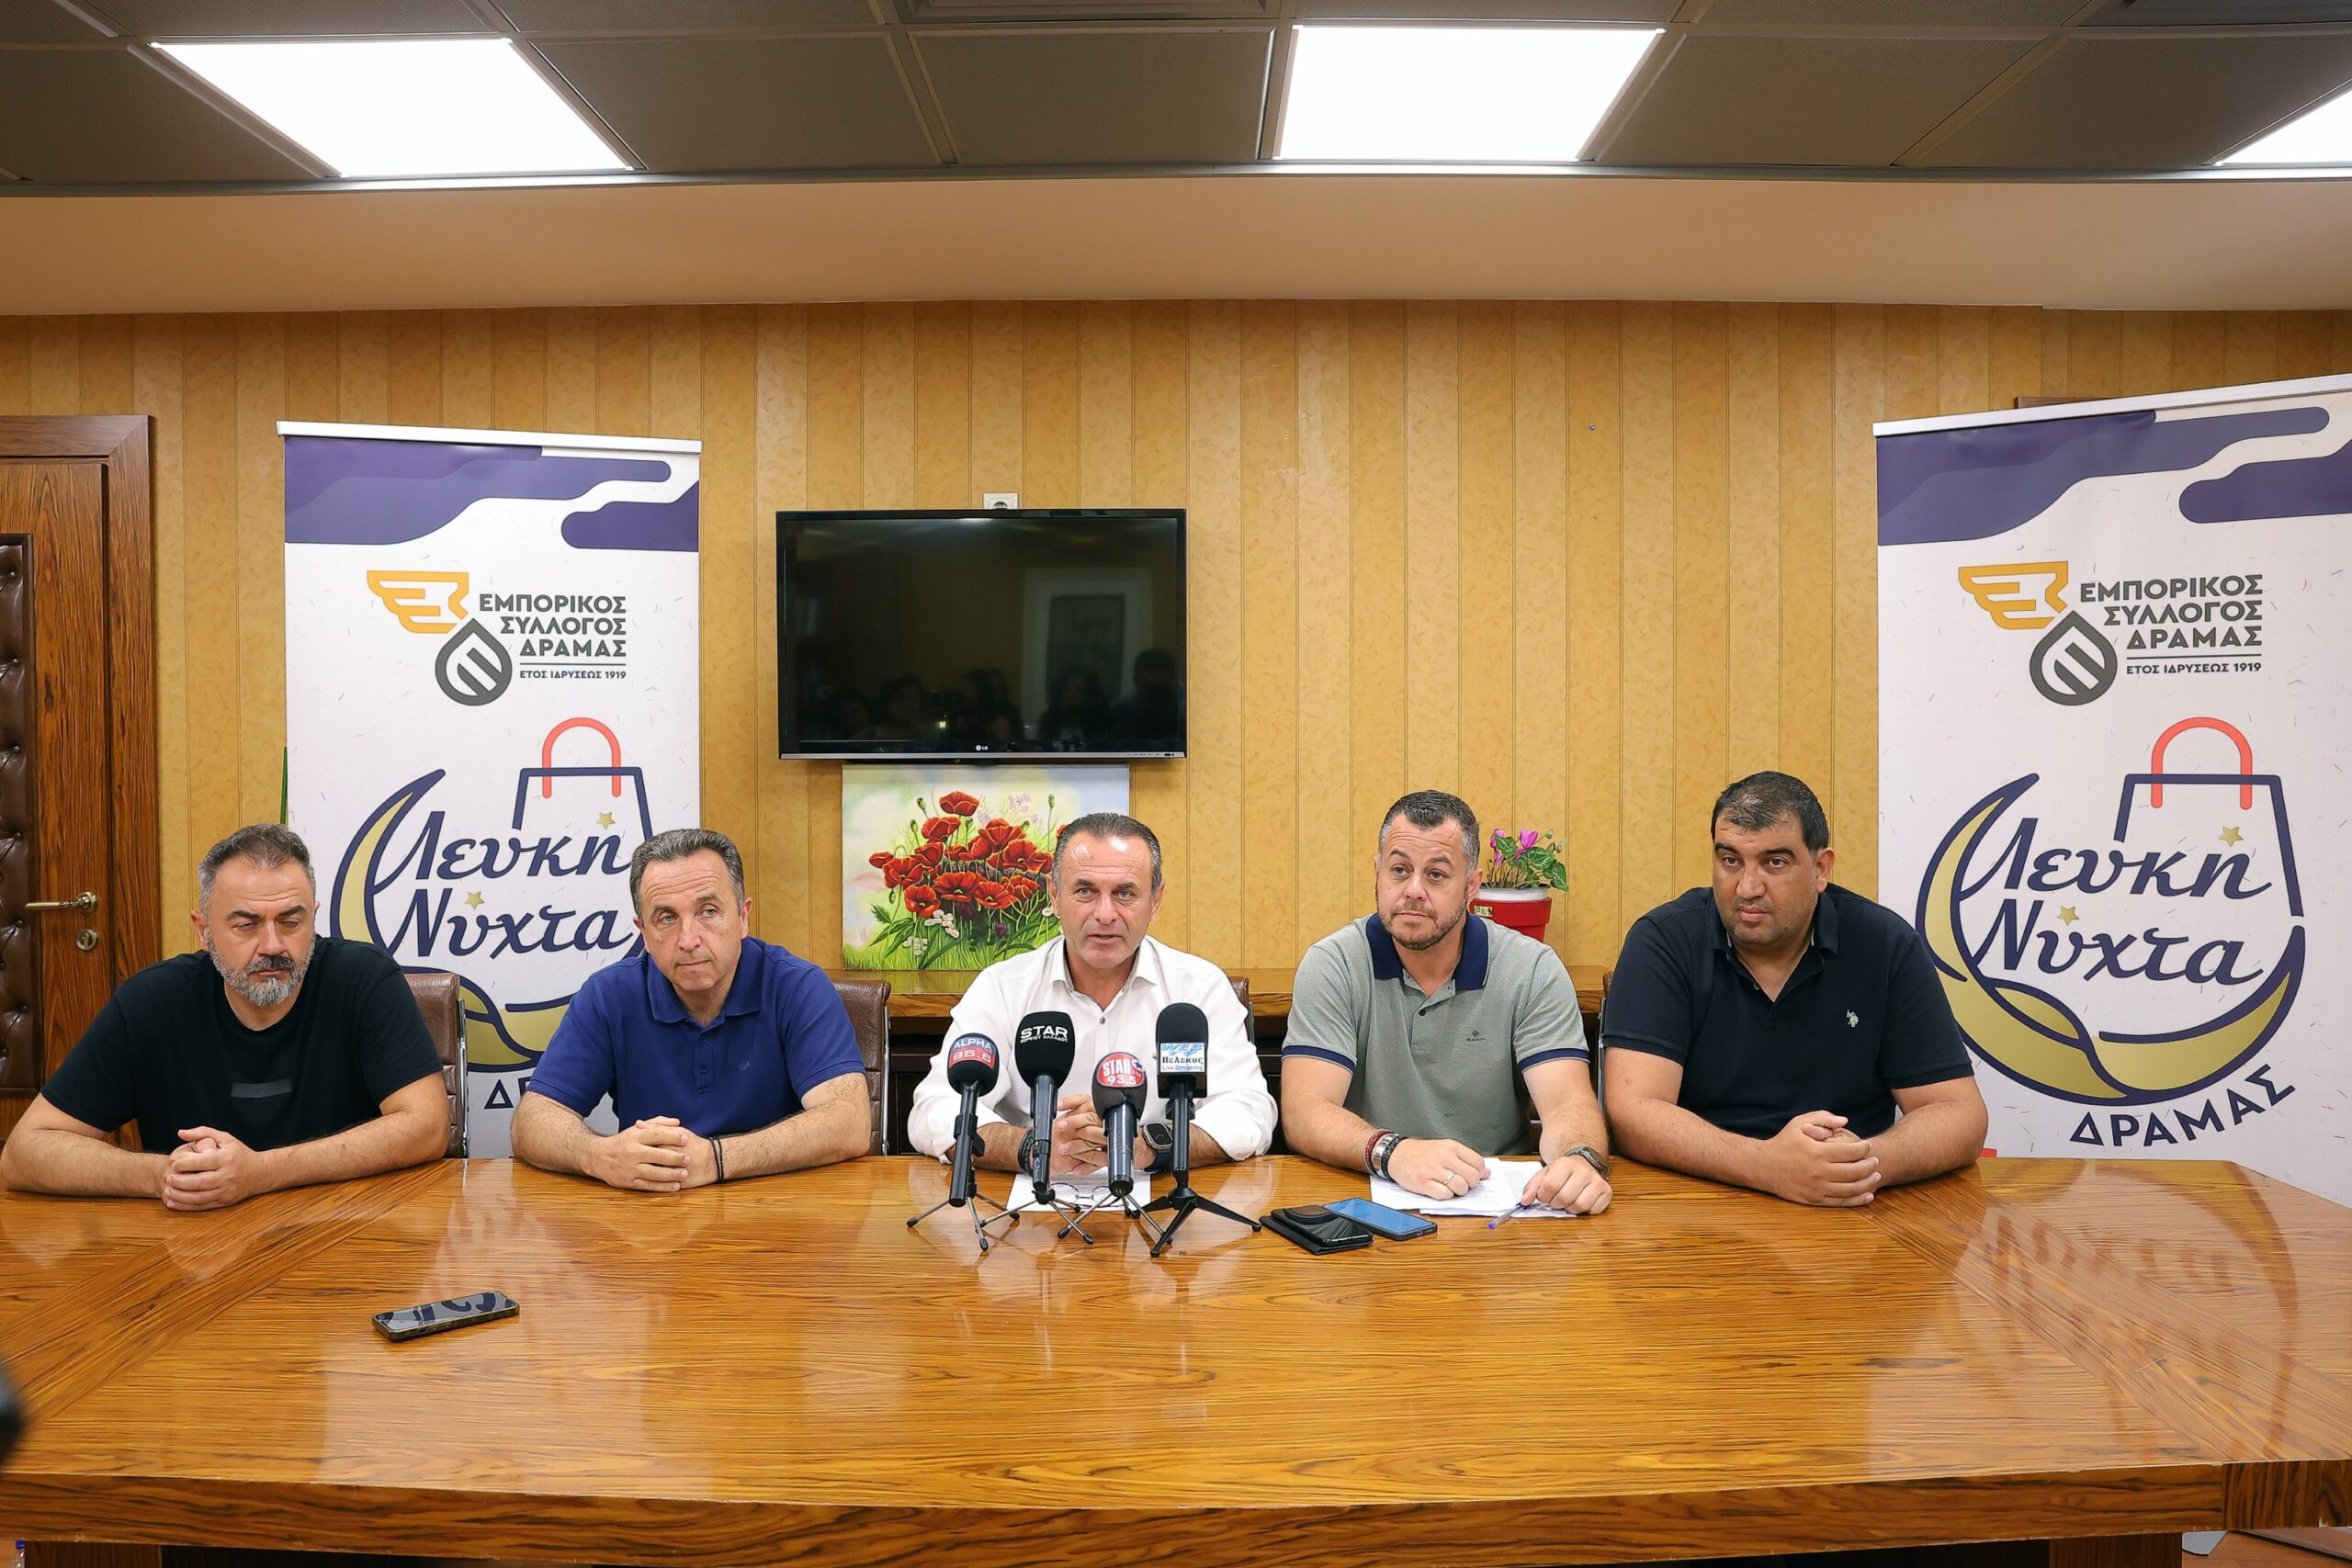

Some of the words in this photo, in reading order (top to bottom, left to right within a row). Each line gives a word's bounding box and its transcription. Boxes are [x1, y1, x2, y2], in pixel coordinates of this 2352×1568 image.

[2080, 574, 2263, 603] ΕΜΠΟΡΙΚΟΣ
[480, 593, 627, 614] ΕΜΠΟΡΙΚΟΣ
[2104, 601, 2262, 626] ΣΥΛΛΟΓΟΣ
[500, 616, 627, 635] ΣΥΛΛΟΓΟΣ
[2126, 626, 2262, 649] ΔΡΑΜΑΣ
[519, 638, 627, 658] ΔΡΑΜΑΣ
[520, 670, 548, 679] ΕΤΟΣ
[550, 671, 602, 679] ΙΔΡΥΣΕΩΣ
[605, 671, 627, 679] 1919
[2126, 664, 2160, 675] ΕΤΟΣ
[2164, 662, 2230, 674] ΙΔΡΥΣΕΩΣ
[2233, 661, 2262, 672] 1919
[1020, 1025, 1069, 1039] STAR
[952, 1037, 993, 1053] ALPHA
[1102, 1058, 1132, 1077] STAR
[1107, 1074, 1136, 1086] 93.5
[2070, 1064, 2296, 1146] ΔΡΑΜΑΣ
